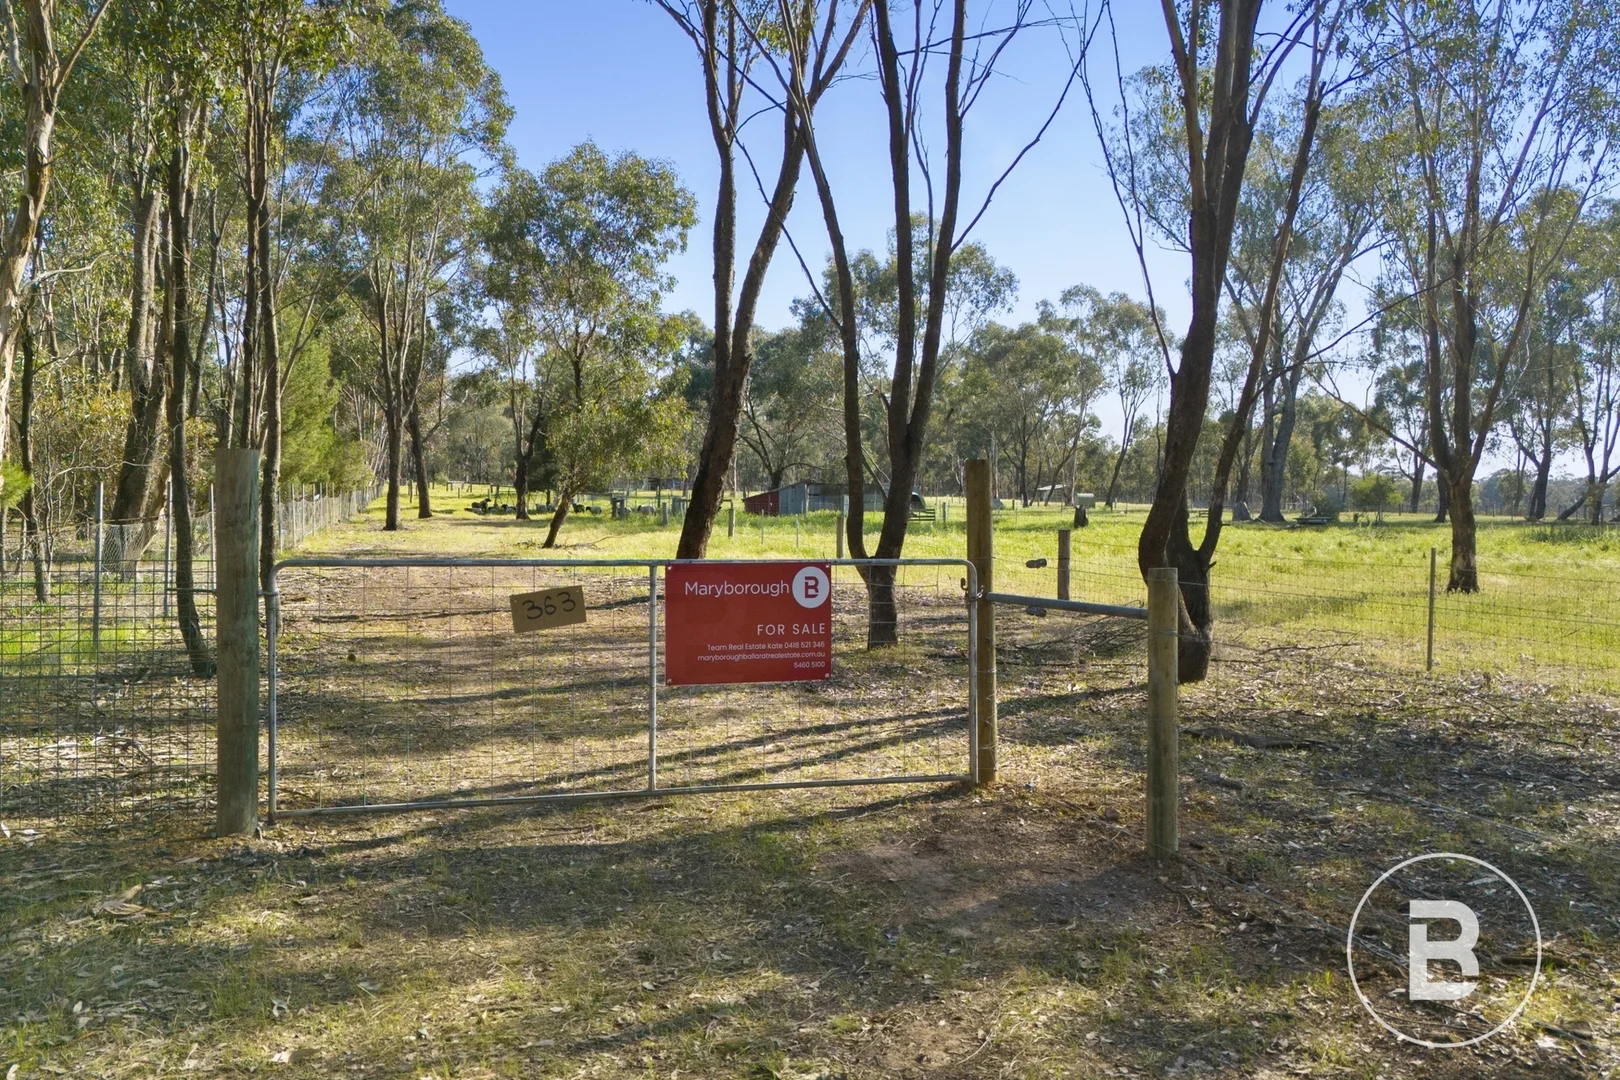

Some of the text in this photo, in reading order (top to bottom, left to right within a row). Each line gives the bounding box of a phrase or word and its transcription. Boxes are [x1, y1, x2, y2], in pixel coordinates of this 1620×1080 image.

[685, 580, 789, 597] Maryborough
[522, 591, 576, 619] 363
[757, 623, 825, 636] FOR SALE
[697, 652, 825, 662] maryboroughballaratrealestate.com.au
